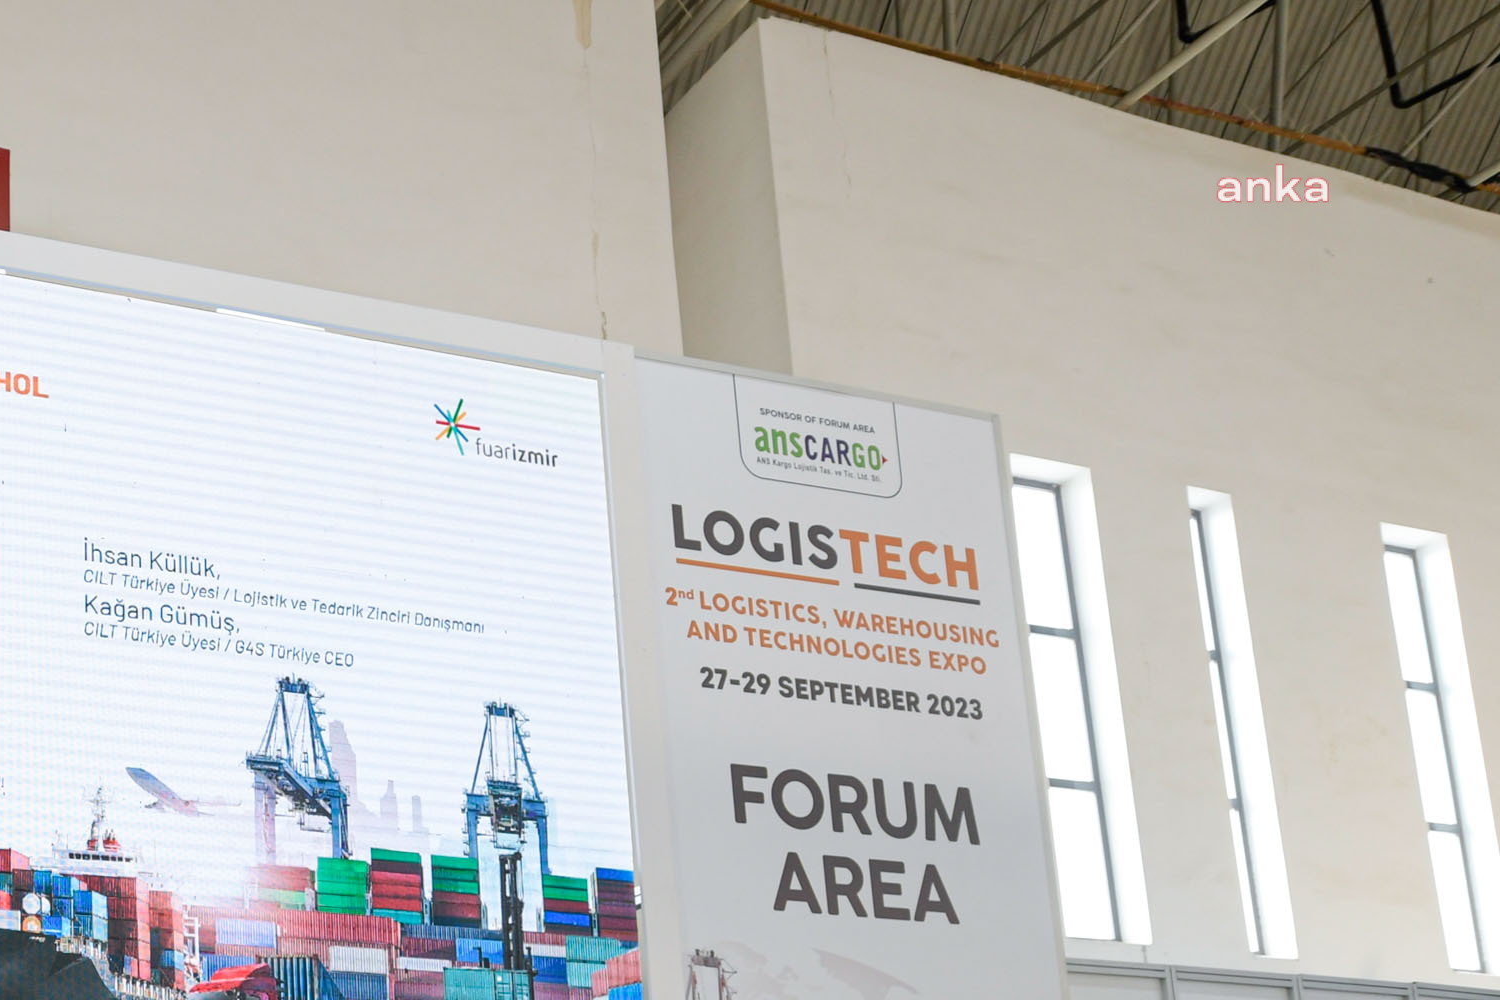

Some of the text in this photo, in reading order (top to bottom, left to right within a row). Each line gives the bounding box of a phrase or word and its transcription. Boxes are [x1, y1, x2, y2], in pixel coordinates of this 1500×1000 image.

[760, 408, 802, 421] SPONSOR
[819, 418, 850, 429] FORUM
[853, 424, 875, 433] AREA
[475, 438, 558, 468] fuarizmir
[772, 459, 792, 469] Kargo
[84, 537, 221, 580] İhsan Küllük,
[672, 503, 979, 591] LOGISTECH
[84, 594, 240, 635] Kağan Gümüş,
[122, 574, 175, 595] Türkiye
[180, 579, 219, 599] Üyesi
[234, 589, 287, 608] Lojistik
[291, 598, 307, 611] ve
[311, 598, 363, 619] Tedarik
[367, 606, 410, 624] Zinciri
[414, 612, 485, 633] Danışmanı
[699, 591, 827, 629] LOGISTICS,
[834, 608, 1000, 648] WAREHOUSING
[123, 626, 177, 648] Türkiye
[181, 630, 221, 651] Üyesi
[235, 640, 265, 656] G4S
[268, 643, 320, 665] Türkiye
[324, 651, 354, 667] CEO
[687, 620, 986, 674] AND TECHNOLOGIES EXPO
[700, 667, 983, 720] 27-29 SEPTEMBER 2023
[730, 763, 980, 845] FORUM
[773, 852, 960, 925] AREA
